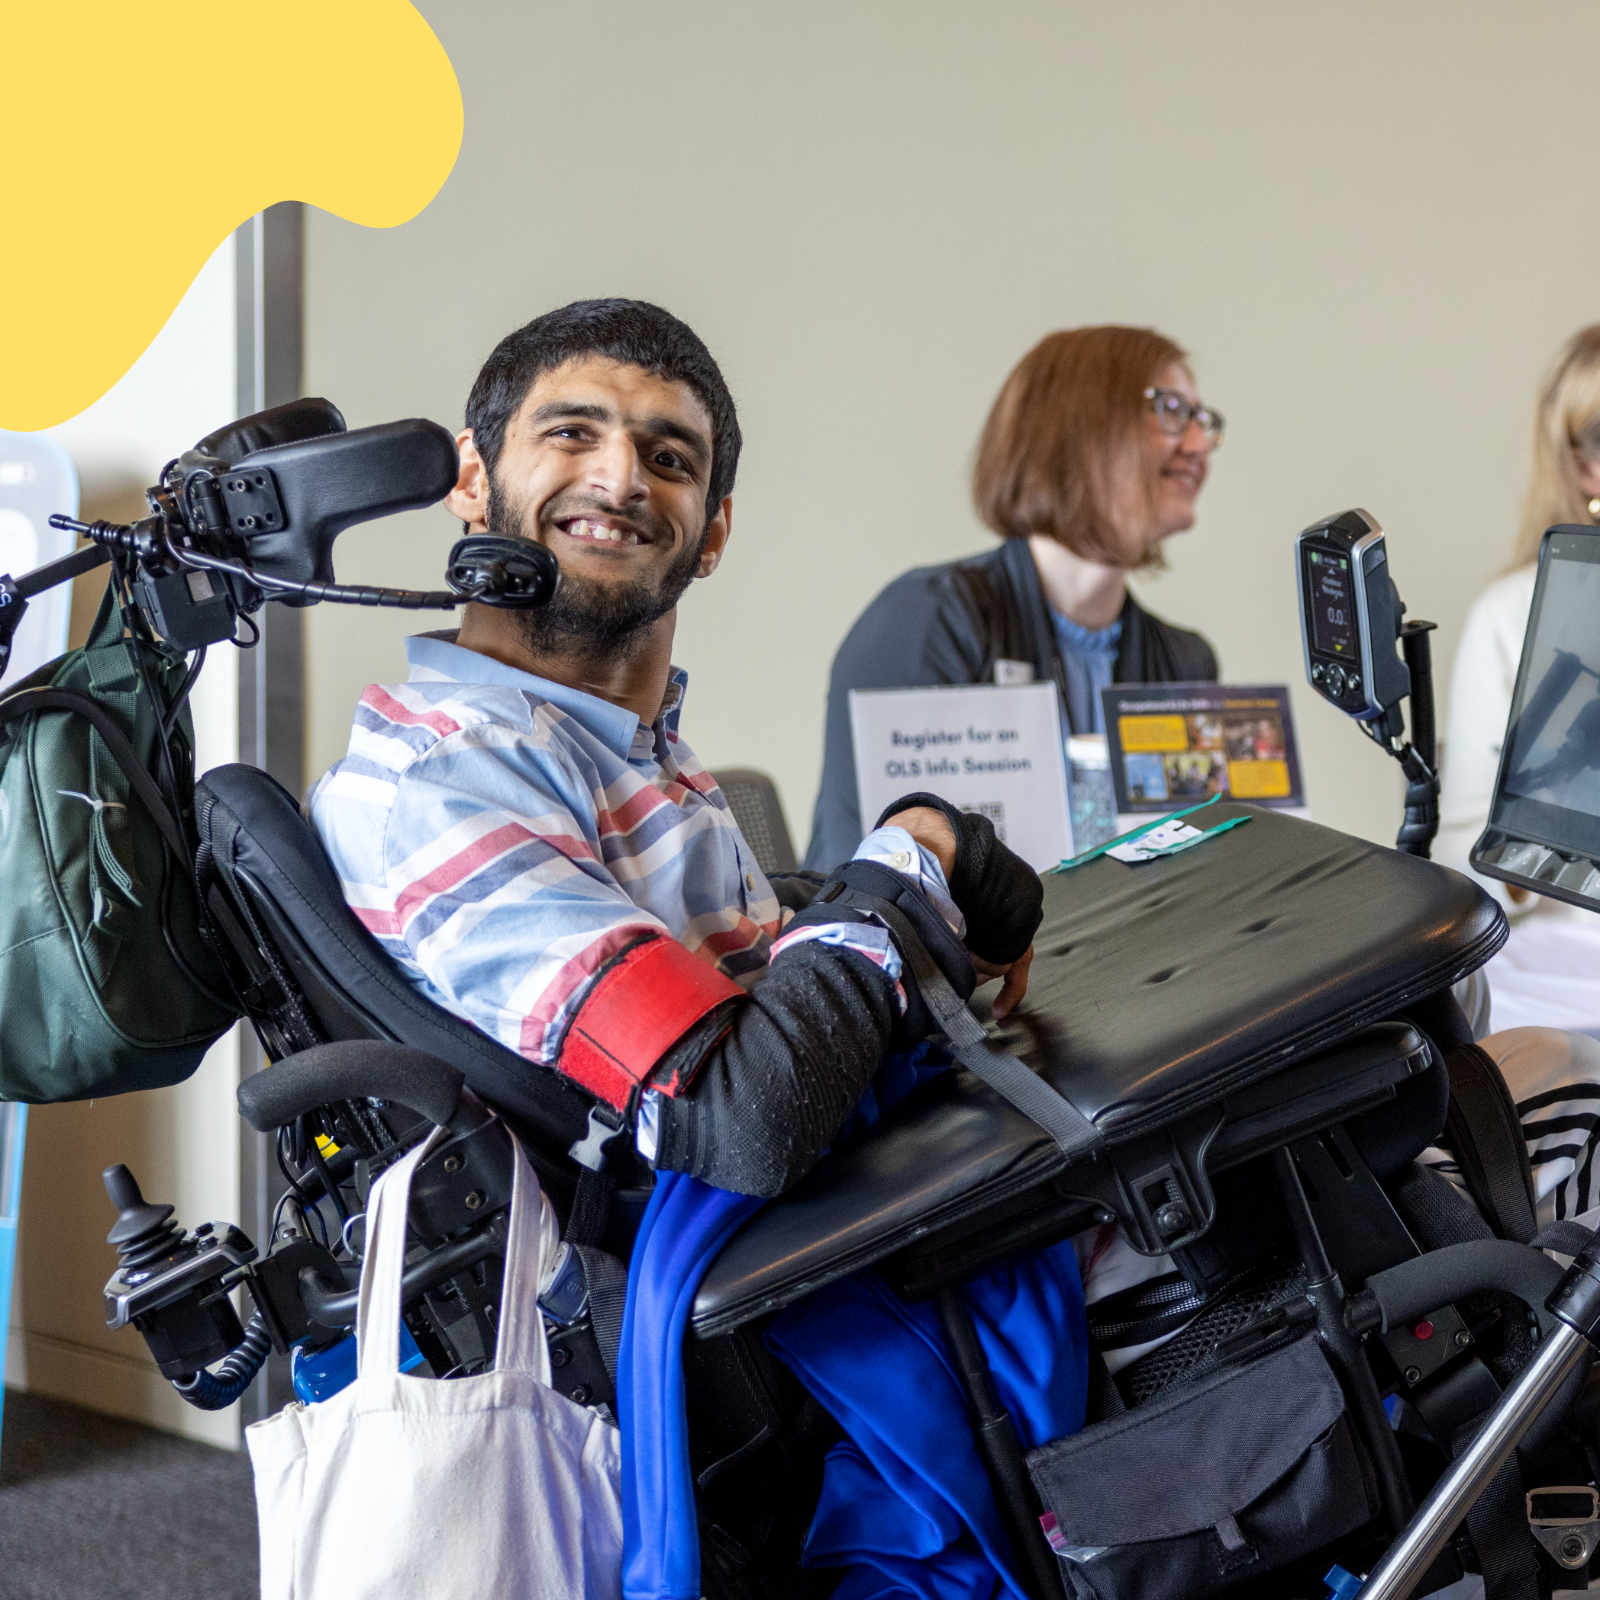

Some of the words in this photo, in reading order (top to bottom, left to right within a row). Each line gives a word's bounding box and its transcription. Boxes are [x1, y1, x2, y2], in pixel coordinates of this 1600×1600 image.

[891, 729, 961, 752] Register
[966, 724, 991, 744] for
[997, 729, 1019, 744] an
[885, 759, 921, 778] OLS
[925, 756, 960, 776] Info
[963, 756, 1031, 775] Session
